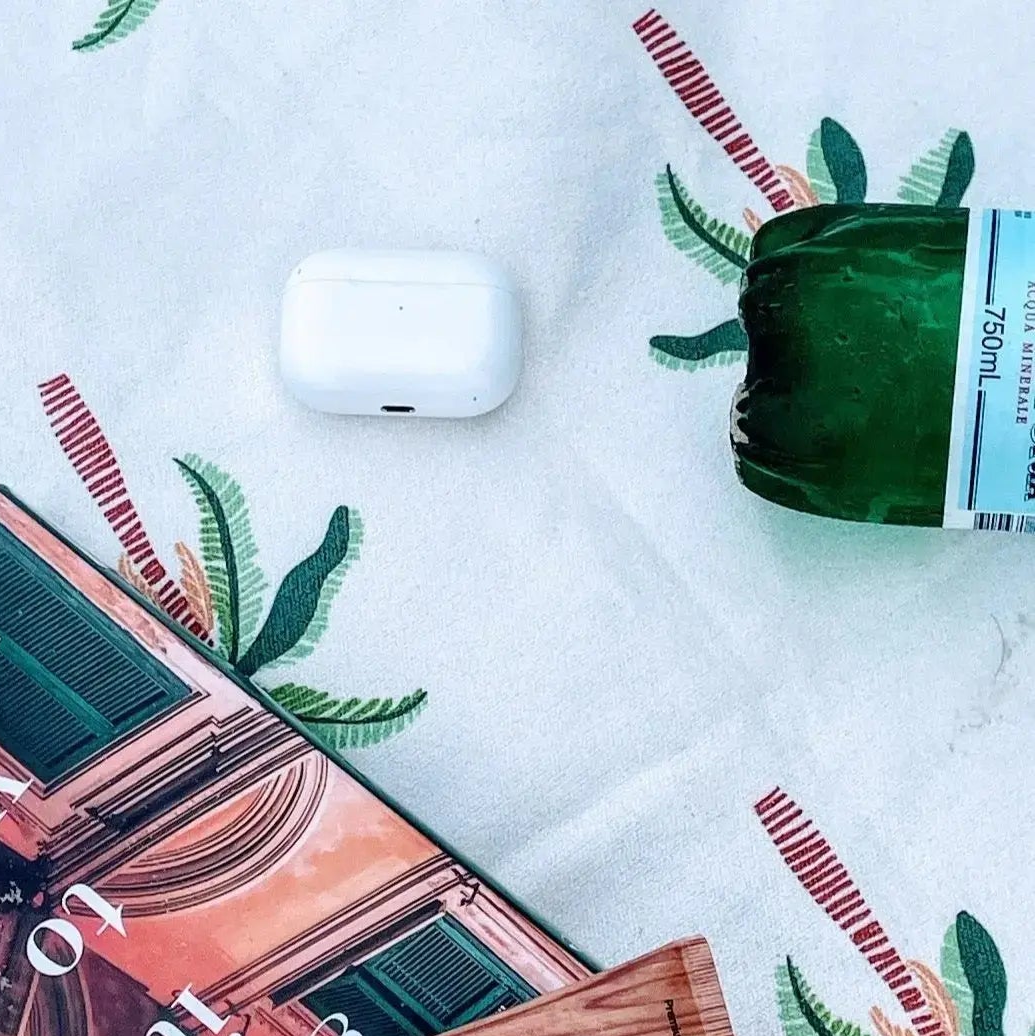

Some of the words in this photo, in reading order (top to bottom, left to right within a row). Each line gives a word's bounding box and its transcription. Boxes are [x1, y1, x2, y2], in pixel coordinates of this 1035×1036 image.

[978, 305, 1006, 387] 750mL
[1016, 342, 1033, 425] MINERALE
[26, 883, 127, 976] to
